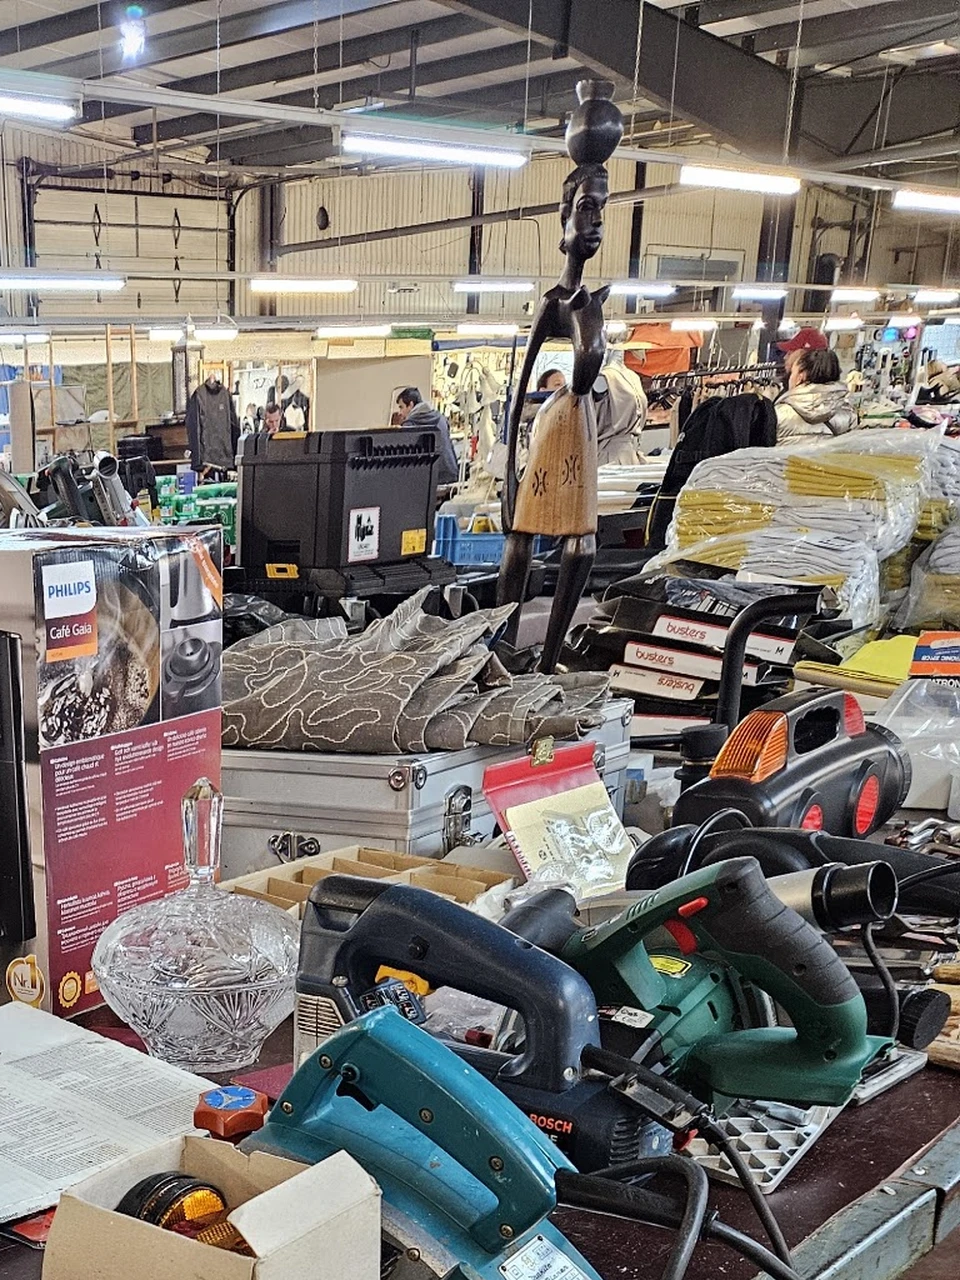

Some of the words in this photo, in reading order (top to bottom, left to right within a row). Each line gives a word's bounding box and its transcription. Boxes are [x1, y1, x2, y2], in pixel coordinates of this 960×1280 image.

[48, 581, 91, 598] PHILIPS
[50, 624, 71, 640] Café
[72, 622, 92, 636] Gaia
[666, 622, 707, 640] busters
[775, 646, 785, 655] M
[635, 647, 675, 666] busters
[657, 676, 695, 694] busters
[529, 1113, 573, 1134] BOSCH
